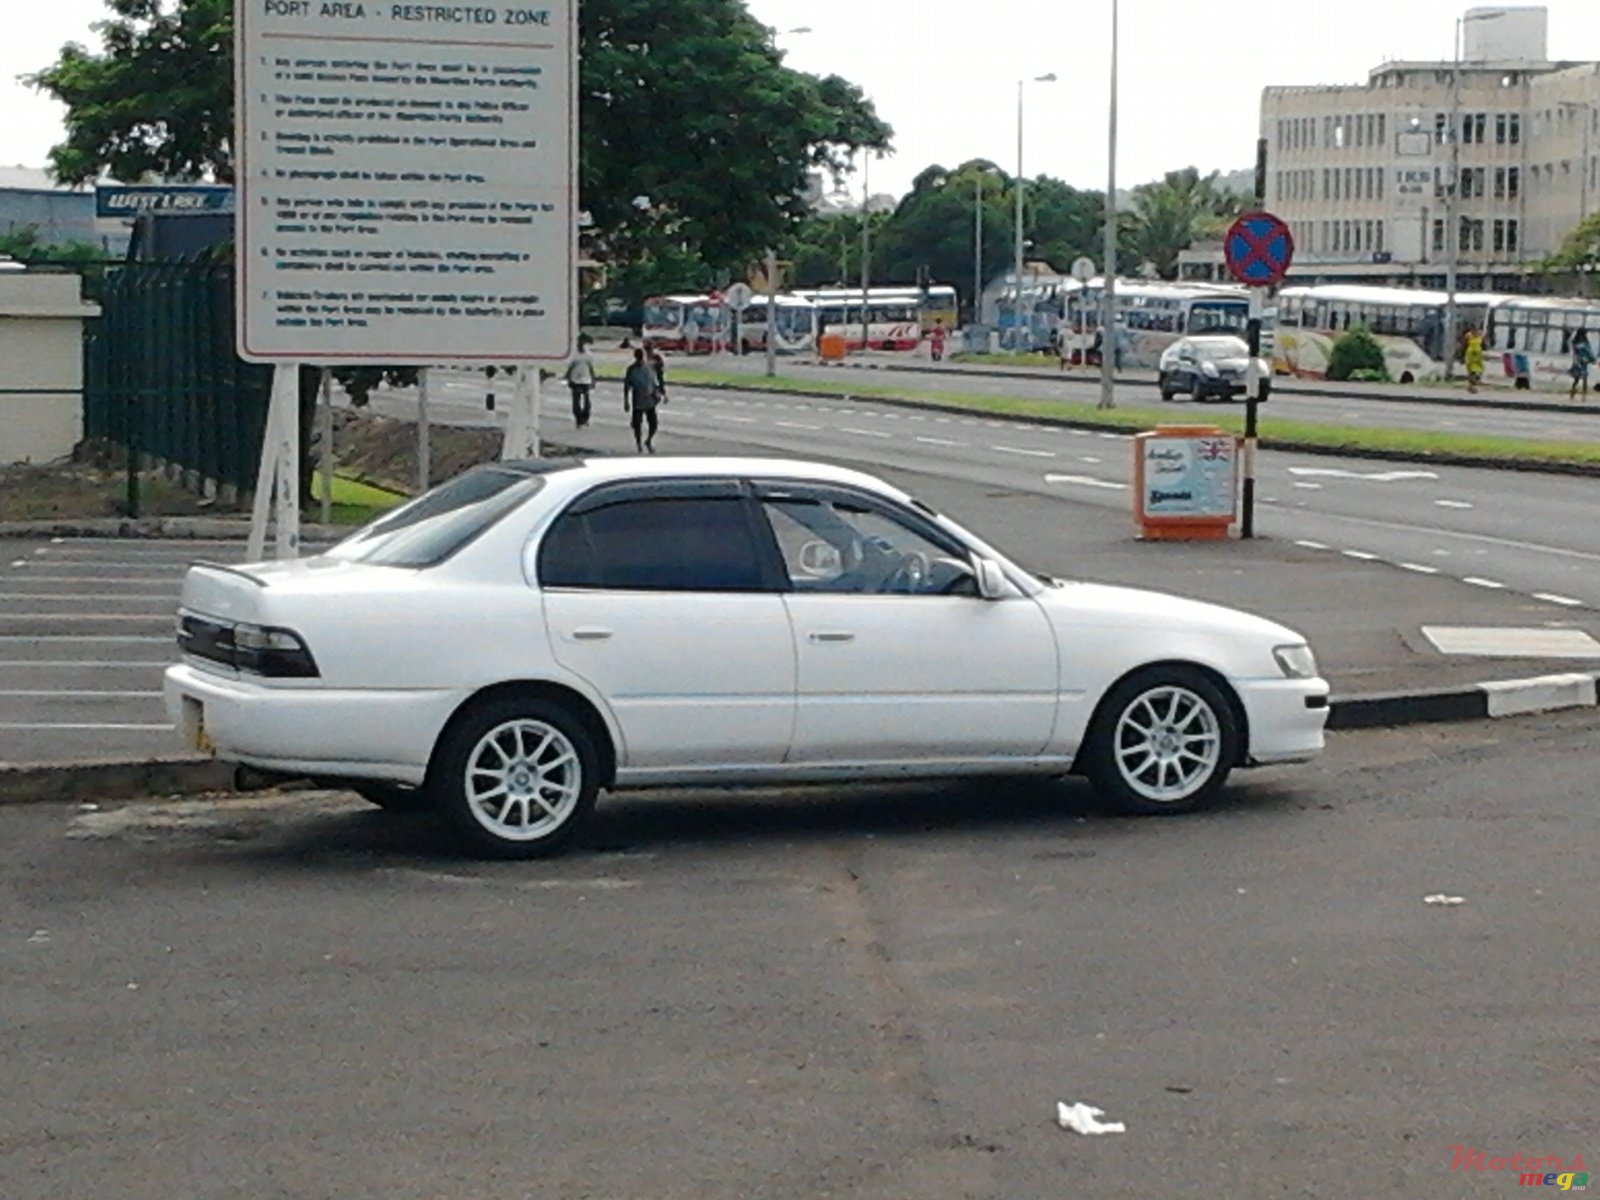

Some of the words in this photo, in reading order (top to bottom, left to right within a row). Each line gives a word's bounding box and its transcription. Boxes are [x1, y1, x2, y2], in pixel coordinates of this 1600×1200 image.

[264, 0, 310, 16] PORT
[320, 3, 366, 18] AREA
[391, 5, 497, 24] RESTRICTED
[504, 9, 550, 26] ZONE
